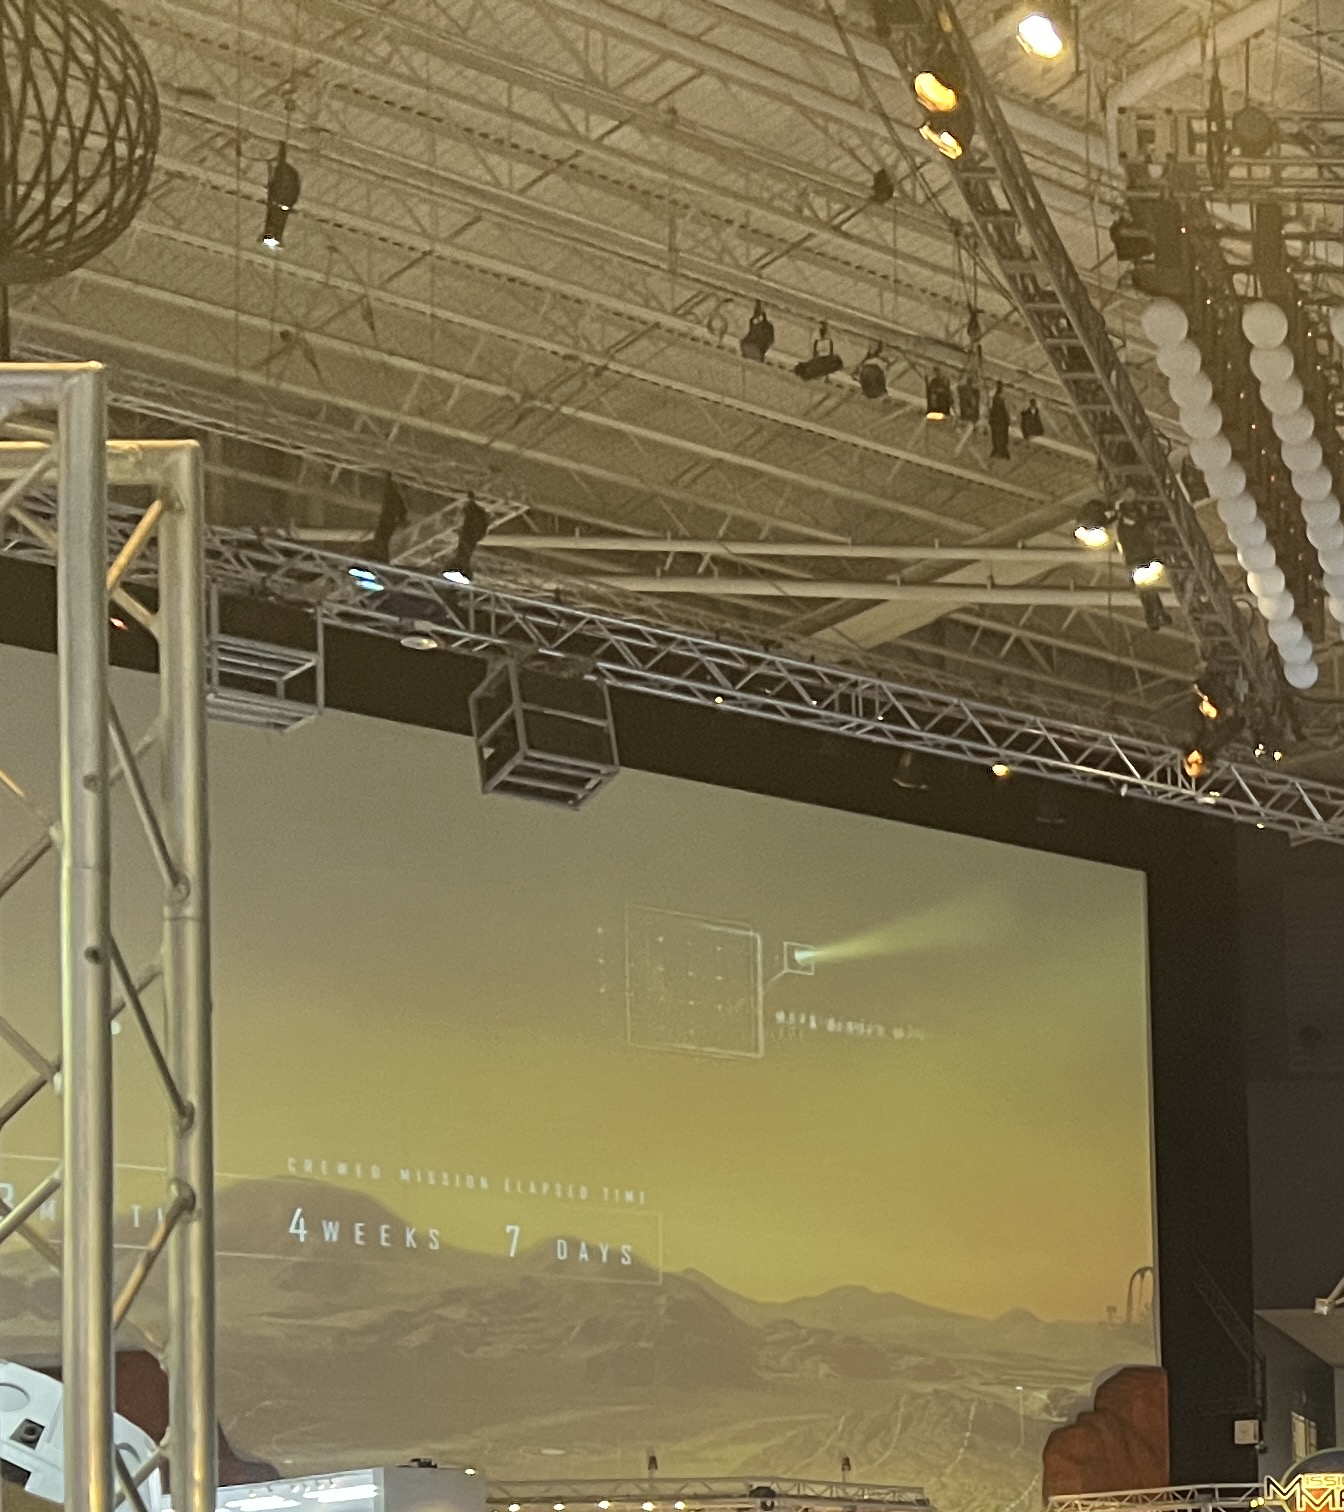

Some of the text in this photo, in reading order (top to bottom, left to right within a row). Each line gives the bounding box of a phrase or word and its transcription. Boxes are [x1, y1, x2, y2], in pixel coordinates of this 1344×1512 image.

[399, 1167, 489, 1191] MISSION
[602, 1187, 645, 1205] TIME
[288, 1206, 633, 1266] 4 WEEKS 7 DAYS
